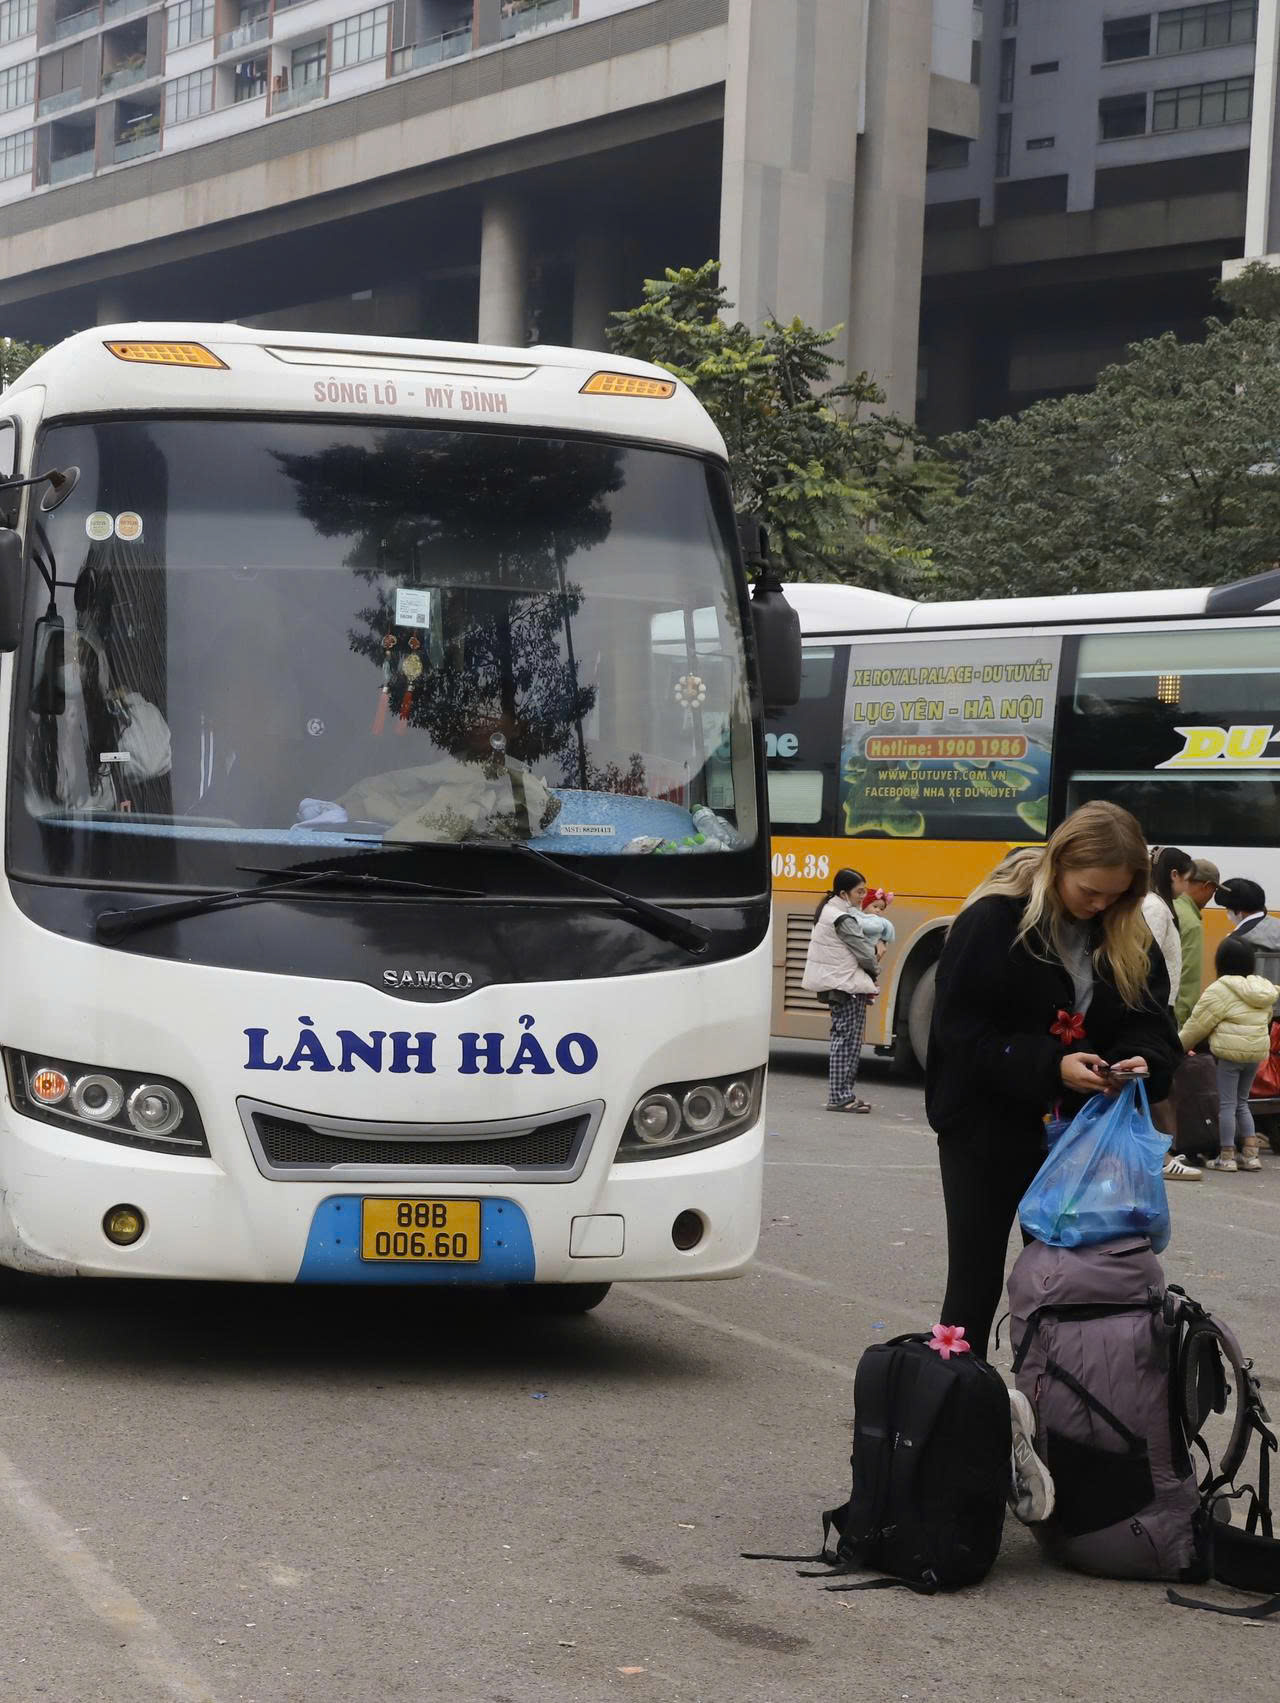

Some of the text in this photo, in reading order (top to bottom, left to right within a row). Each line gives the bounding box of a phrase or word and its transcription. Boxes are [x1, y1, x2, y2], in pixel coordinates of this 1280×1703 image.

[313, 376, 368, 404] SÔNG
[373, 380, 398, 405] LÔ
[425, 383, 455, 409] MỸ
[460, 385, 508, 413] ĐÌNH
[853, 669, 871, 687] XE
[871, 666, 917, 687] ROYAL
[919, 665, 973, 686] PALACE
[982, 664, 1004, 683] DU
[1005, 658, 1052, 682] TUYẾT
[854, 701, 895, 725] LỤC
[900, 697, 944, 721] YÊN
[963, 695, 995, 720] HÀ
[1000, 694, 1044, 724] NỘI
[871, 738, 1021, 757] Hotline: 1900 1986
[949, 786, 961, 798] XE
[964, 786, 979, 798] DU
[383, 969, 473, 990] SAMCO
[243, 1014, 598, 1075] LÀNH HẢO
[397, 1203, 447, 1228] 88B
[375, 1232, 467, 1257] 006.60
